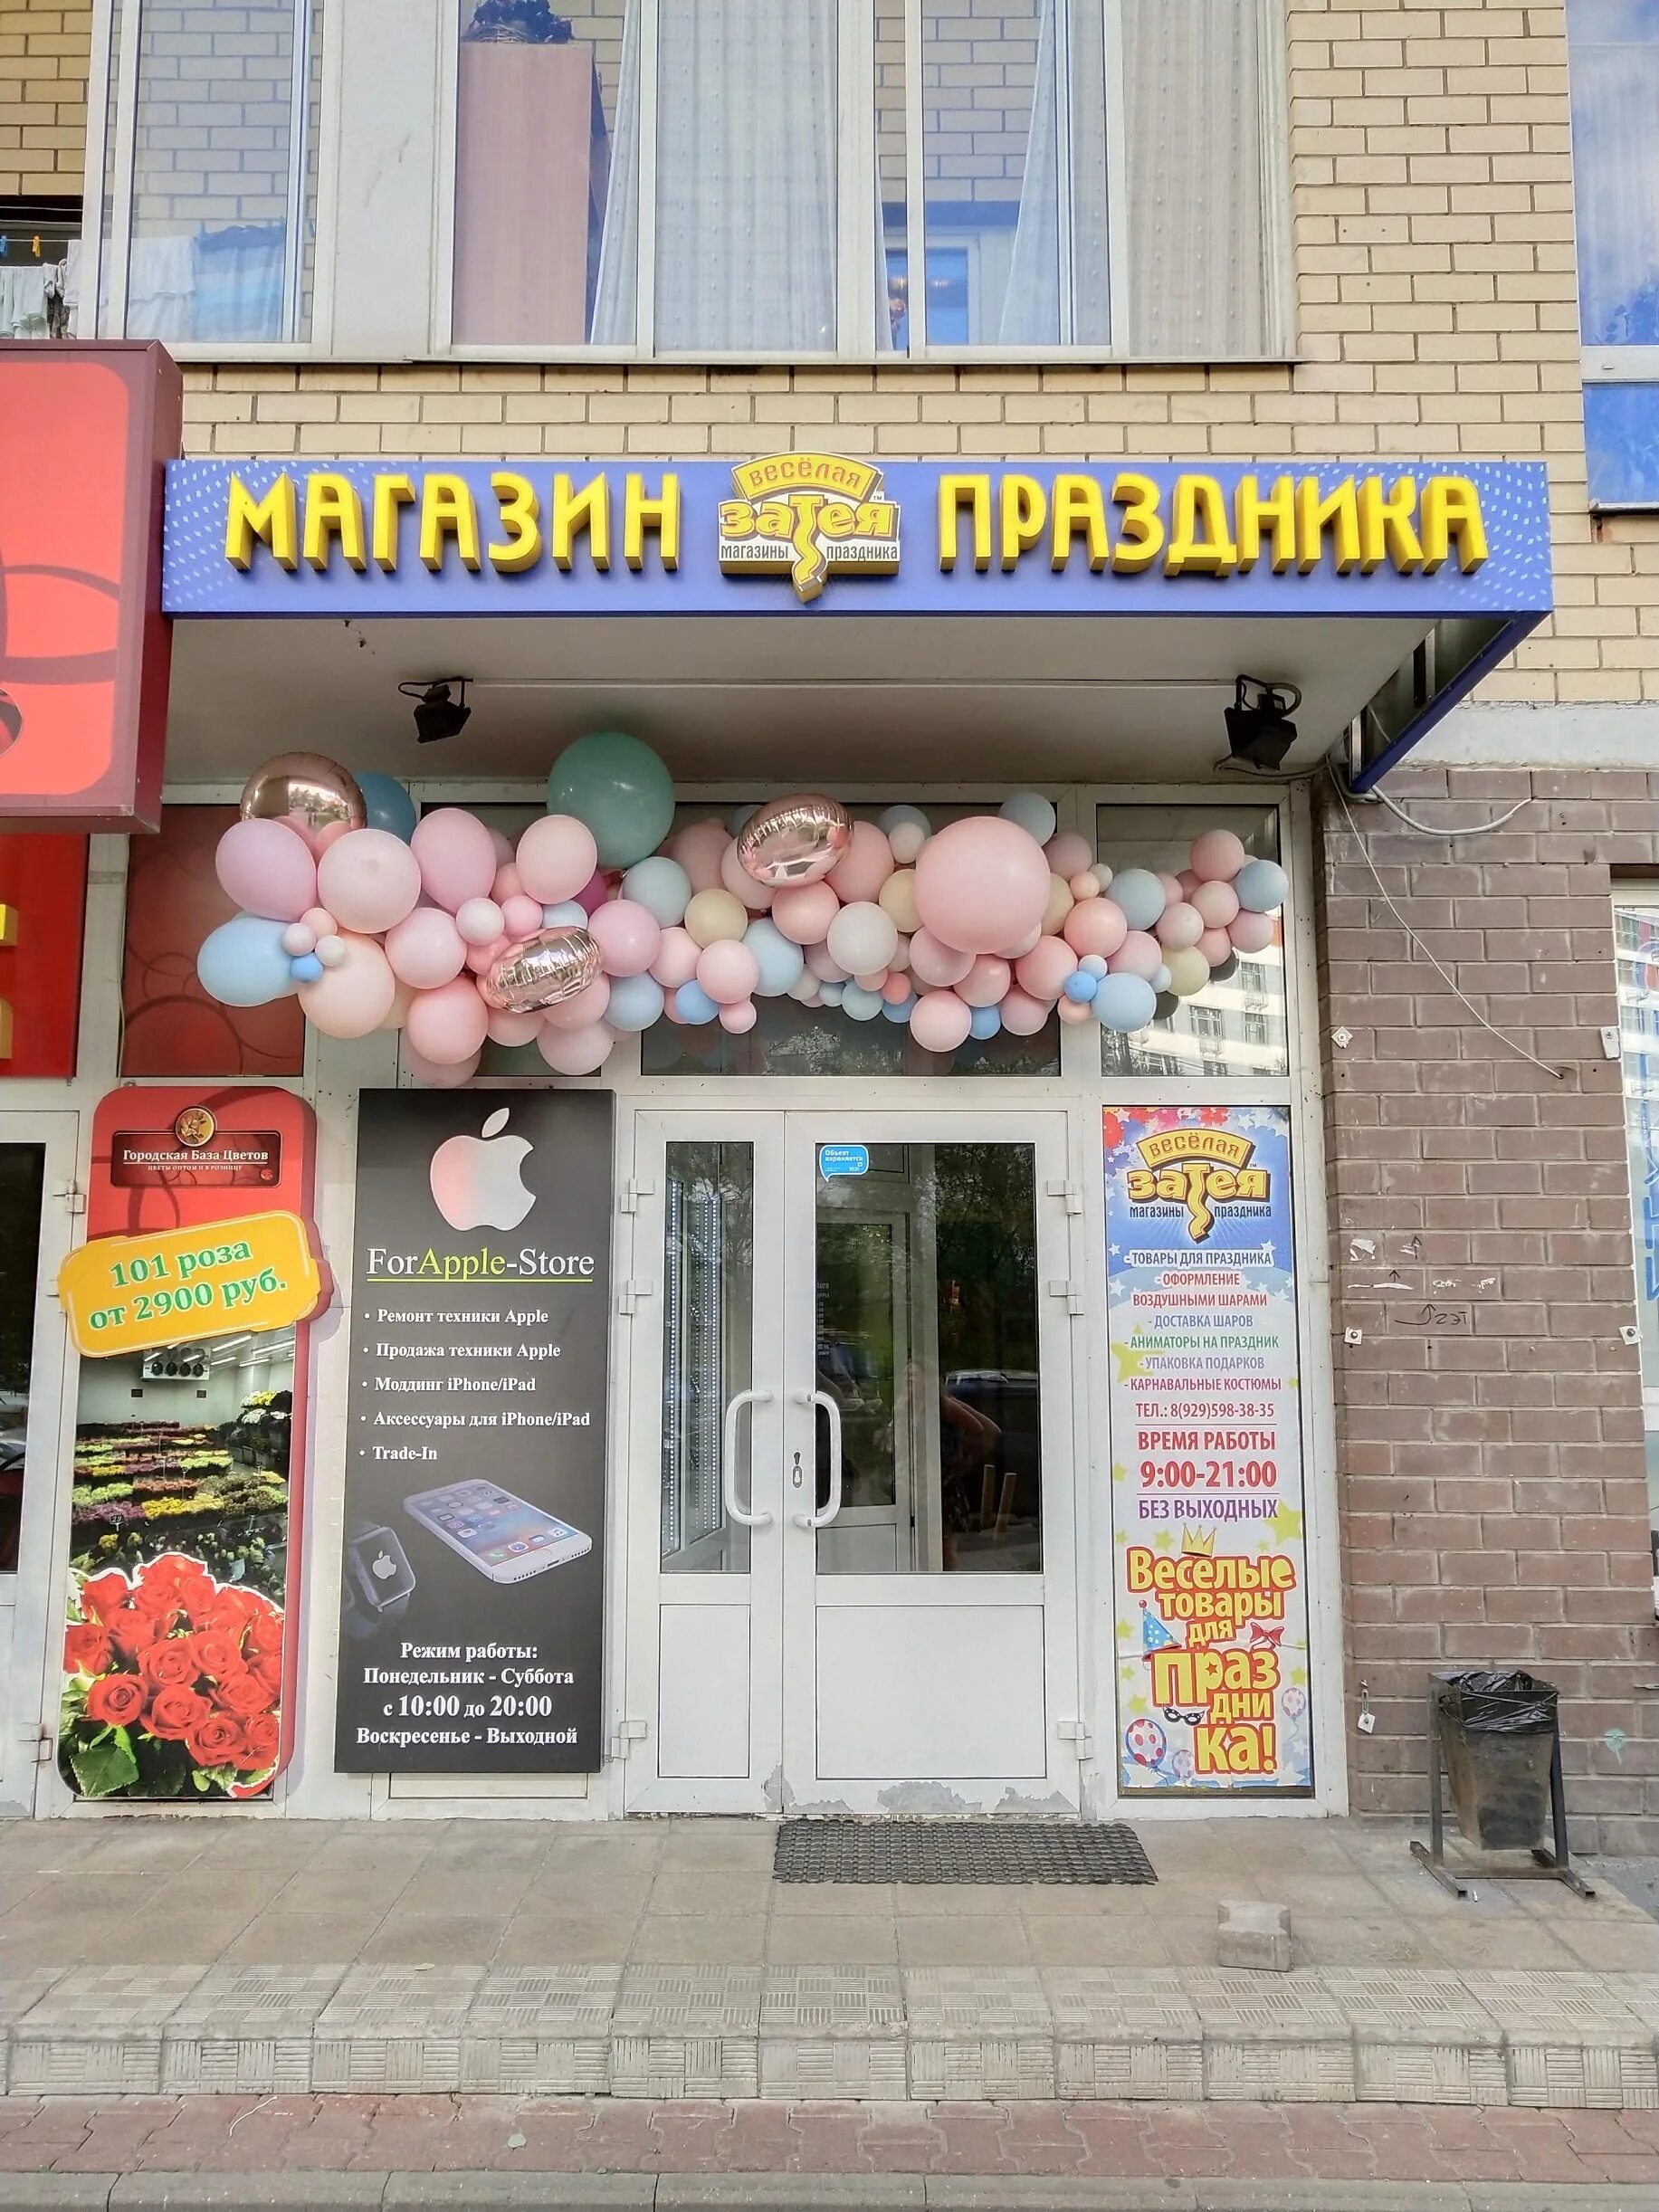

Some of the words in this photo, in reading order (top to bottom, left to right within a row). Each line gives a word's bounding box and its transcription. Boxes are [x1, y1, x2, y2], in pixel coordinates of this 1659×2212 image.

[225, 472, 680, 572] МАГАЗИН
[939, 472, 1489, 577] ПРАЗДНИКА
[720, 545, 788, 559] магазины
[826, 545, 898, 561] праздника
[123, 1149, 187, 1162] Городская
[191, 1149, 220, 1160] База
[224, 1149, 269, 1161] Цветов
[1130, 1206, 1184, 1218] магазины
[1215, 1206, 1272, 1219] праздника
[110, 1254, 169, 1287] 101
[177, 1241, 253, 1279] роза
[367, 1247, 595, 1281] ForApple-Store
[1132, 1253, 1177, 1264] ТОВАРЫ
[1180, 1253, 1202, 1266] ДЛЯ
[1206, 1253, 1272, 1266] ПРАЗДНИКА
[1163, 1273, 1240, 1285] ОФОРМЛЕНИЕ
[89, 1305, 126, 1330] от
[133, 1282, 213, 1321] 2900
[221, 1267, 287, 1307] руб.
[1133, 1293, 1216, 1308] ВОЗДУШНЫМИ
[1218, 1294, 1267, 1306] ШАРАМИ
[377, 1309, 434, 1323] Ремонт
[437, 1311, 500, 1323] техники
[504, 1310, 548, 1326] Apple
[1154, 1315, 1211, 1330] ДОСТАВКА
[1214, 1315, 1254, 1328] ШАРОВ
[376, 1343, 444, 1360] Продажа
[449, 1346, 512, 1358] техники
[517, 1344, 561, 1360] Apple
[1131, 1336, 1200, 1349] АНИМАТОРЫ
[1203, 1336, 1217, 1349] НА
[1221, 1336, 1279, 1350] ПРАЗДНИК
[1146, 1358, 1203, 1369] УПАКОВКА
[1206, 1358, 1264, 1371] ПОДАРКОВ
[374, 1378, 443, 1393] Моддинг
[447, 1377, 536, 1391] iPhone/iPad
[1131, 1378, 1222, 1391] КАРНАВАЛЬНЫЕ
[1224, 1378, 1282, 1391] КОСТЮМЫ
[1136, 1403, 1168, 1417] ТЕЛ.:
[1170, 1402, 1274, 1419] 8(929)598-38-35
[373, 1412, 465, 1429] Аксессуары
[469, 1415, 497, 1428] для
[501, 1411, 590, 1426] iPhone/iPad
[1138, 1431, 1198, 1450] ВРЕМЯ
[1204, 1431, 1275, 1450] РАБОТЫ
[373, 1445, 438, 1460] Trade-In
[1140, 1460, 1277, 1488] 9:00-21:00
[1139, 1499, 1169, 1519] БЕЗ
[1174, 1499, 1278, 1522] ВЫХОДНЫХ
[1158, 1591, 1282, 1625] товары
[1188, 1620, 1234, 1646] для
[400, 1643, 460, 1659] Режим
[465, 1642, 538, 1662] работы:
[363, 1668, 485, 1685] Понедельник
[501, 1667, 574, 1687] Суббота
[398, 1694, 460, 1717] 10:00
[463, 1703, 485, 1719] до
[490, 1694, 552, 1717] 20:00
[357, 1728, 471, 1748] Воскресенье
[486, 1726, 577, 1746] Выходной
